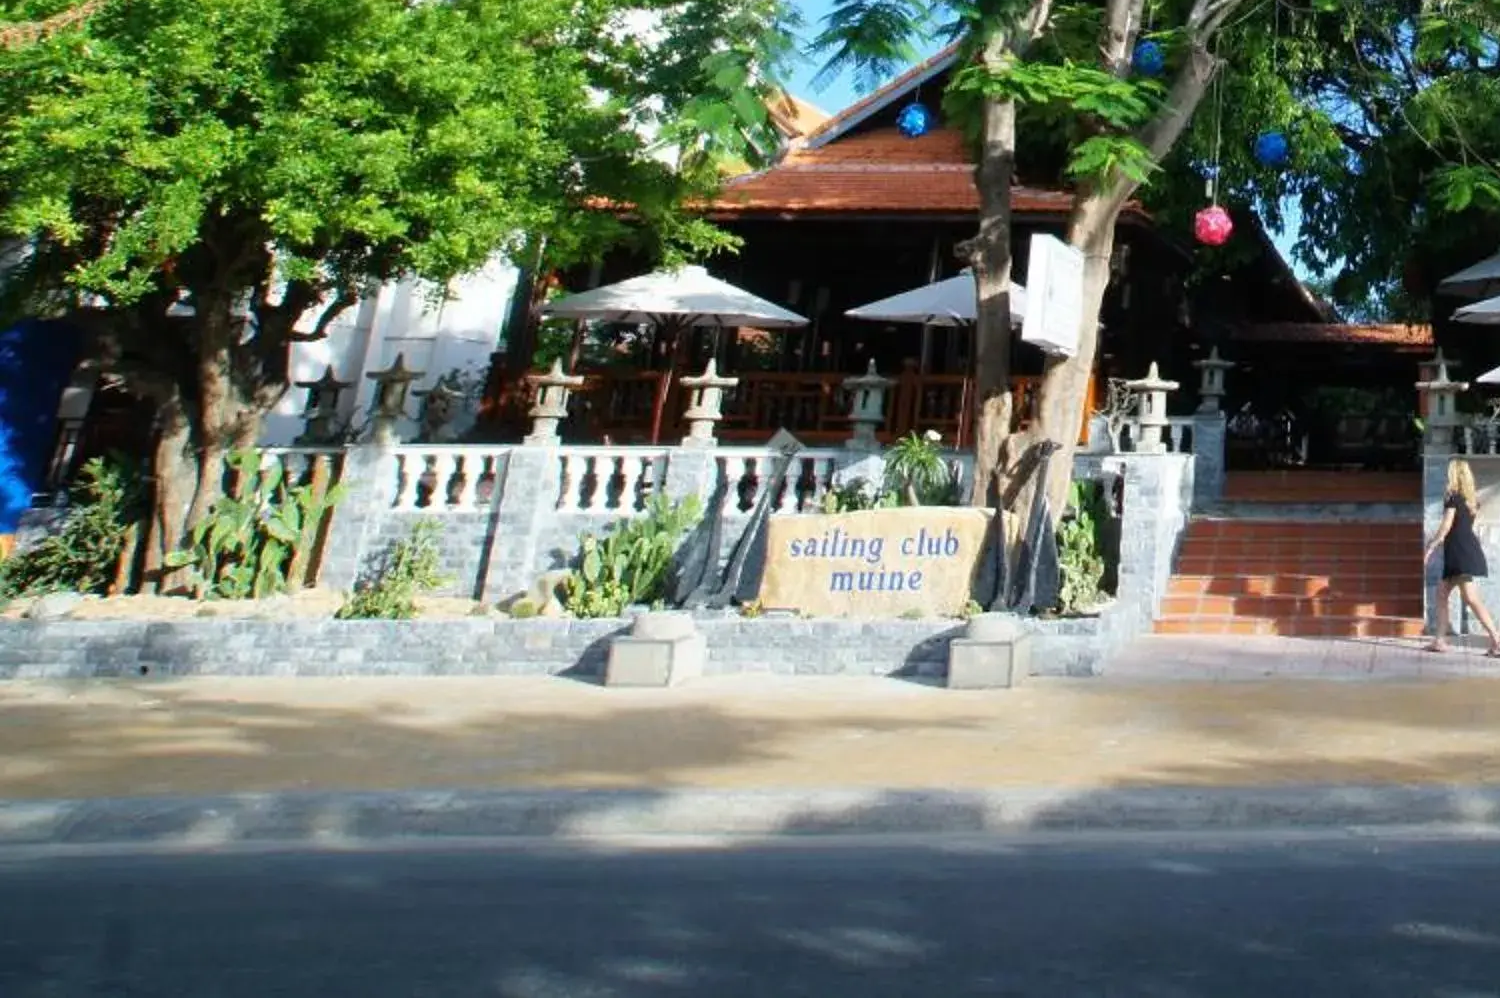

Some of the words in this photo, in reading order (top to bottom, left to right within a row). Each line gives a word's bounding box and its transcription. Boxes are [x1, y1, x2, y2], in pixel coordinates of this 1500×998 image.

[790, 527, 884, 563] sailing
[901, 527, 960, 556] club
[830, 564, 923, 592] muine
